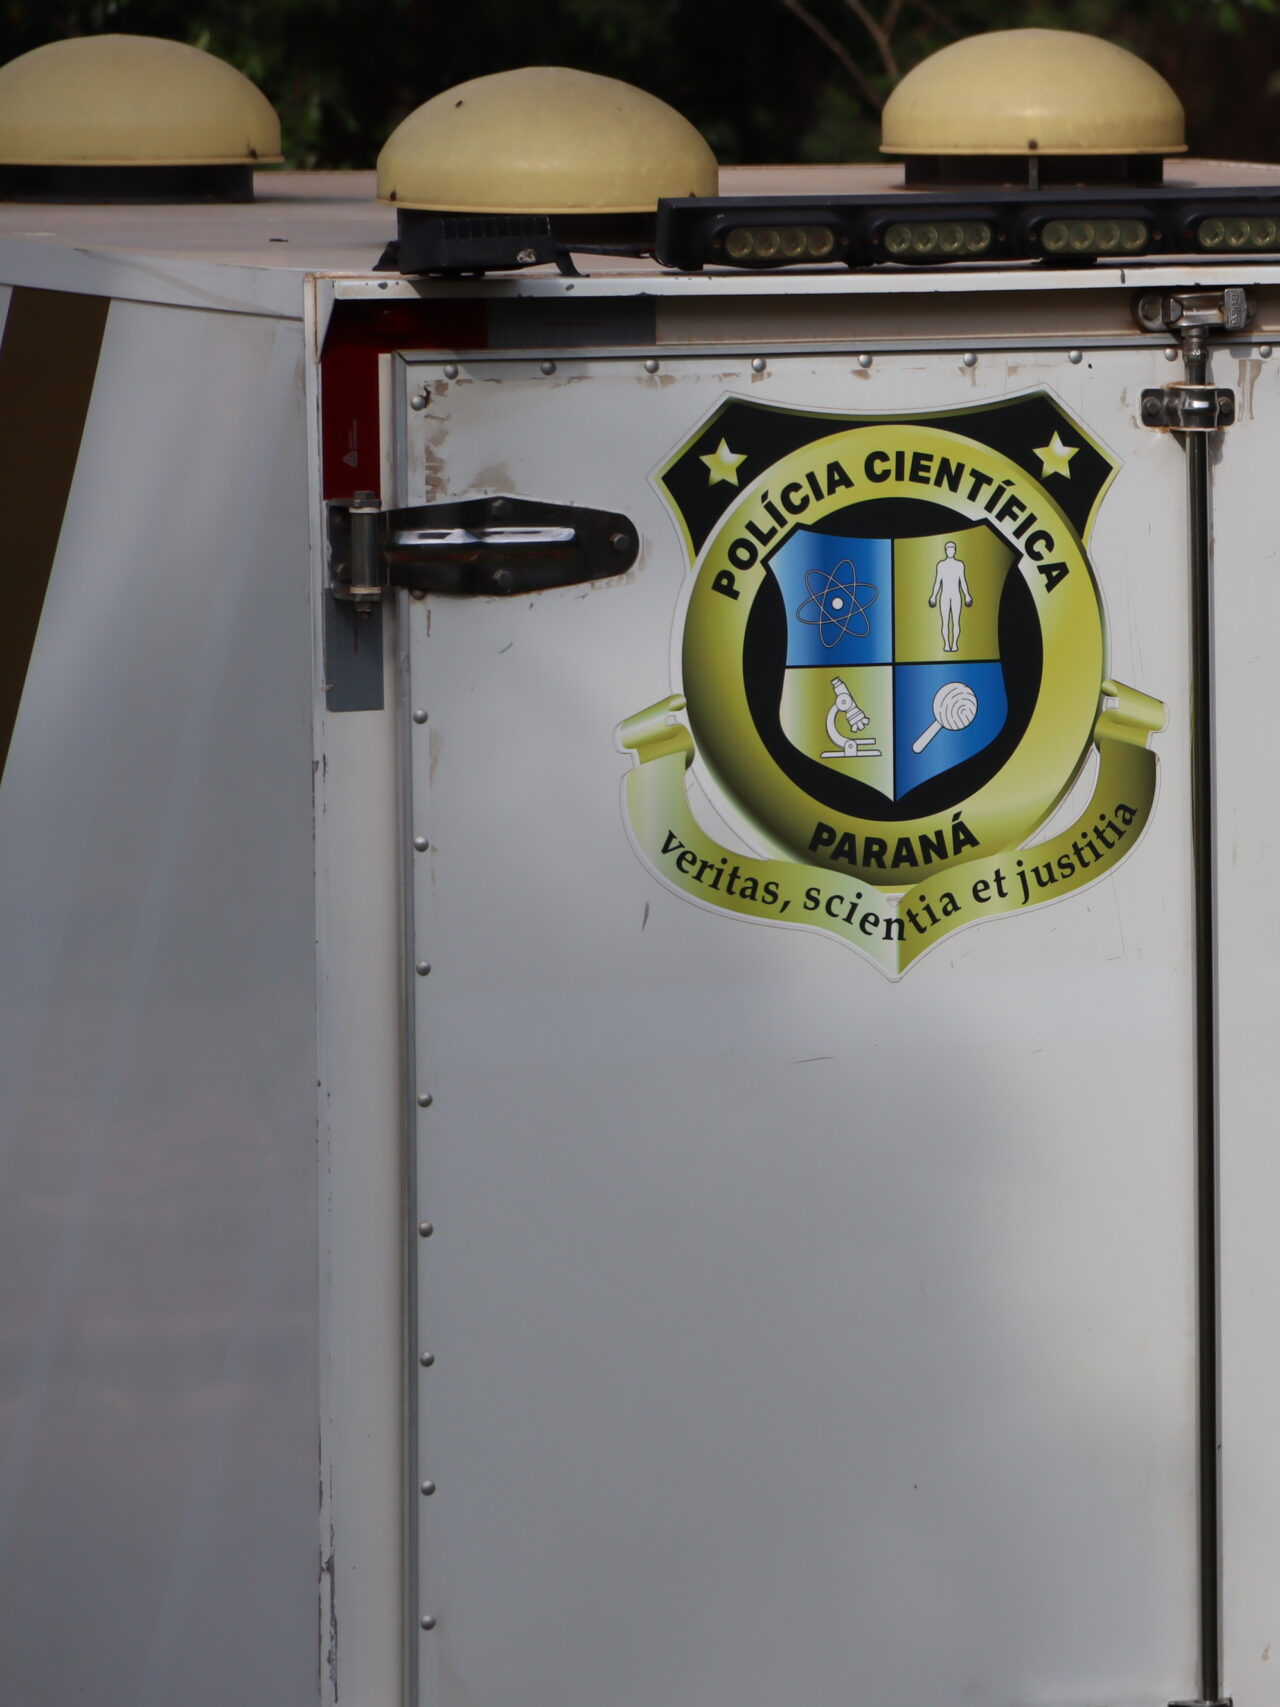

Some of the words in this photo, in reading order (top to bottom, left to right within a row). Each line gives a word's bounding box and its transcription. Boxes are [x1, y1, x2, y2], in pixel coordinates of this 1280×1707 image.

[711, 461, 854, 601] POLÍCIA
[864, 450, 1070, 593] CIENTÍFICA
[660, 830, 791, 913] veritas,
[803, 887, 961, 941] scientia
[972, 868, 1008, 903] et
[1016, 803, 1139, 905] justitia
[808, 811, 980, 869] PARANÁ
